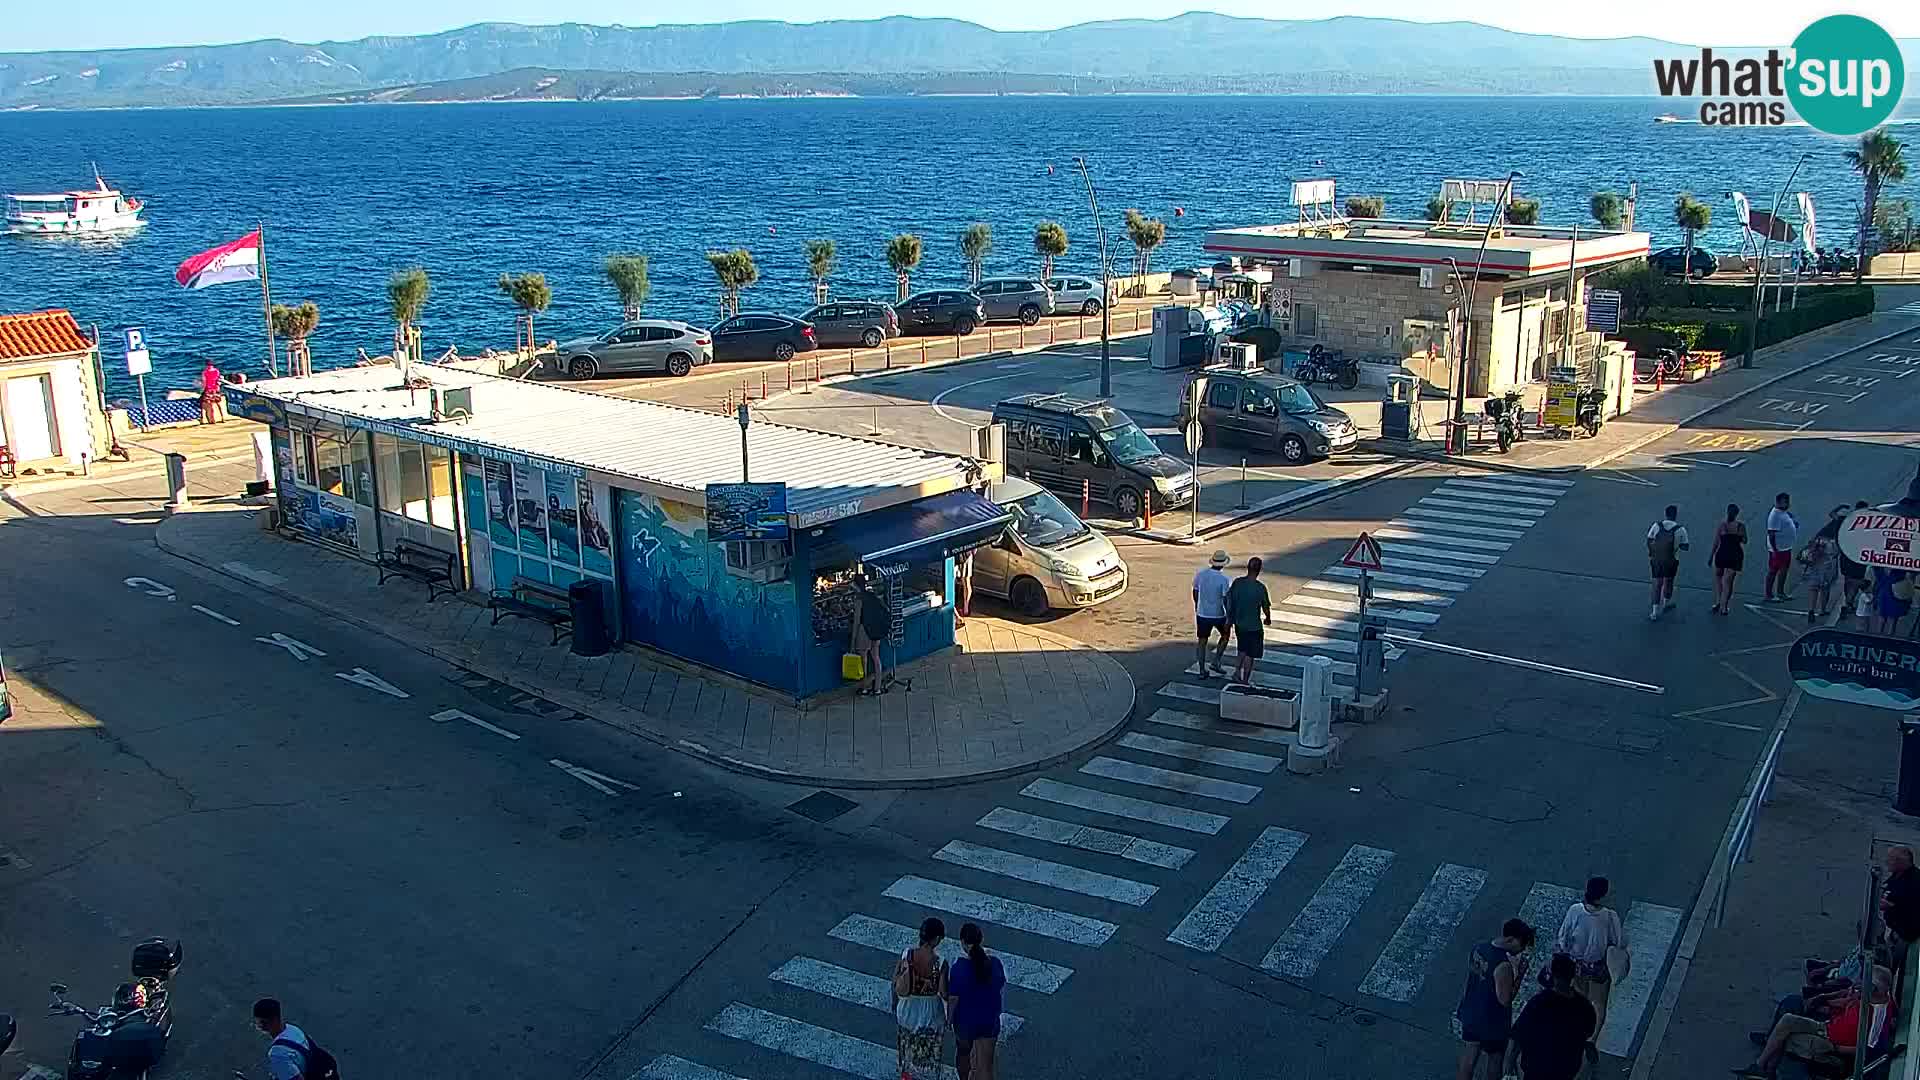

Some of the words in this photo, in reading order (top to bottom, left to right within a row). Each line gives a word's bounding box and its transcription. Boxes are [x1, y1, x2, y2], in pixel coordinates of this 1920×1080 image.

[128, 330, 142, 350] P
[1816, 374, 1880, 388] TAXI
[1759, 399, 1830, 415] TAXI
[1685, 432, 1765, 449] TAXI
[437, 437, 468, 451] POSTAJA
[478, 445, 493, 457] BUS
[494, 449, 526, 465] STATION
[528, 457, 556, 473] TICKET
[555, 462, 582, 478] OFFICE
[1848, 515, 1920, 533] PIZZE
[1801, 642, 1920, 672] MARINER
[1871, 665, 1897, 680] bar
